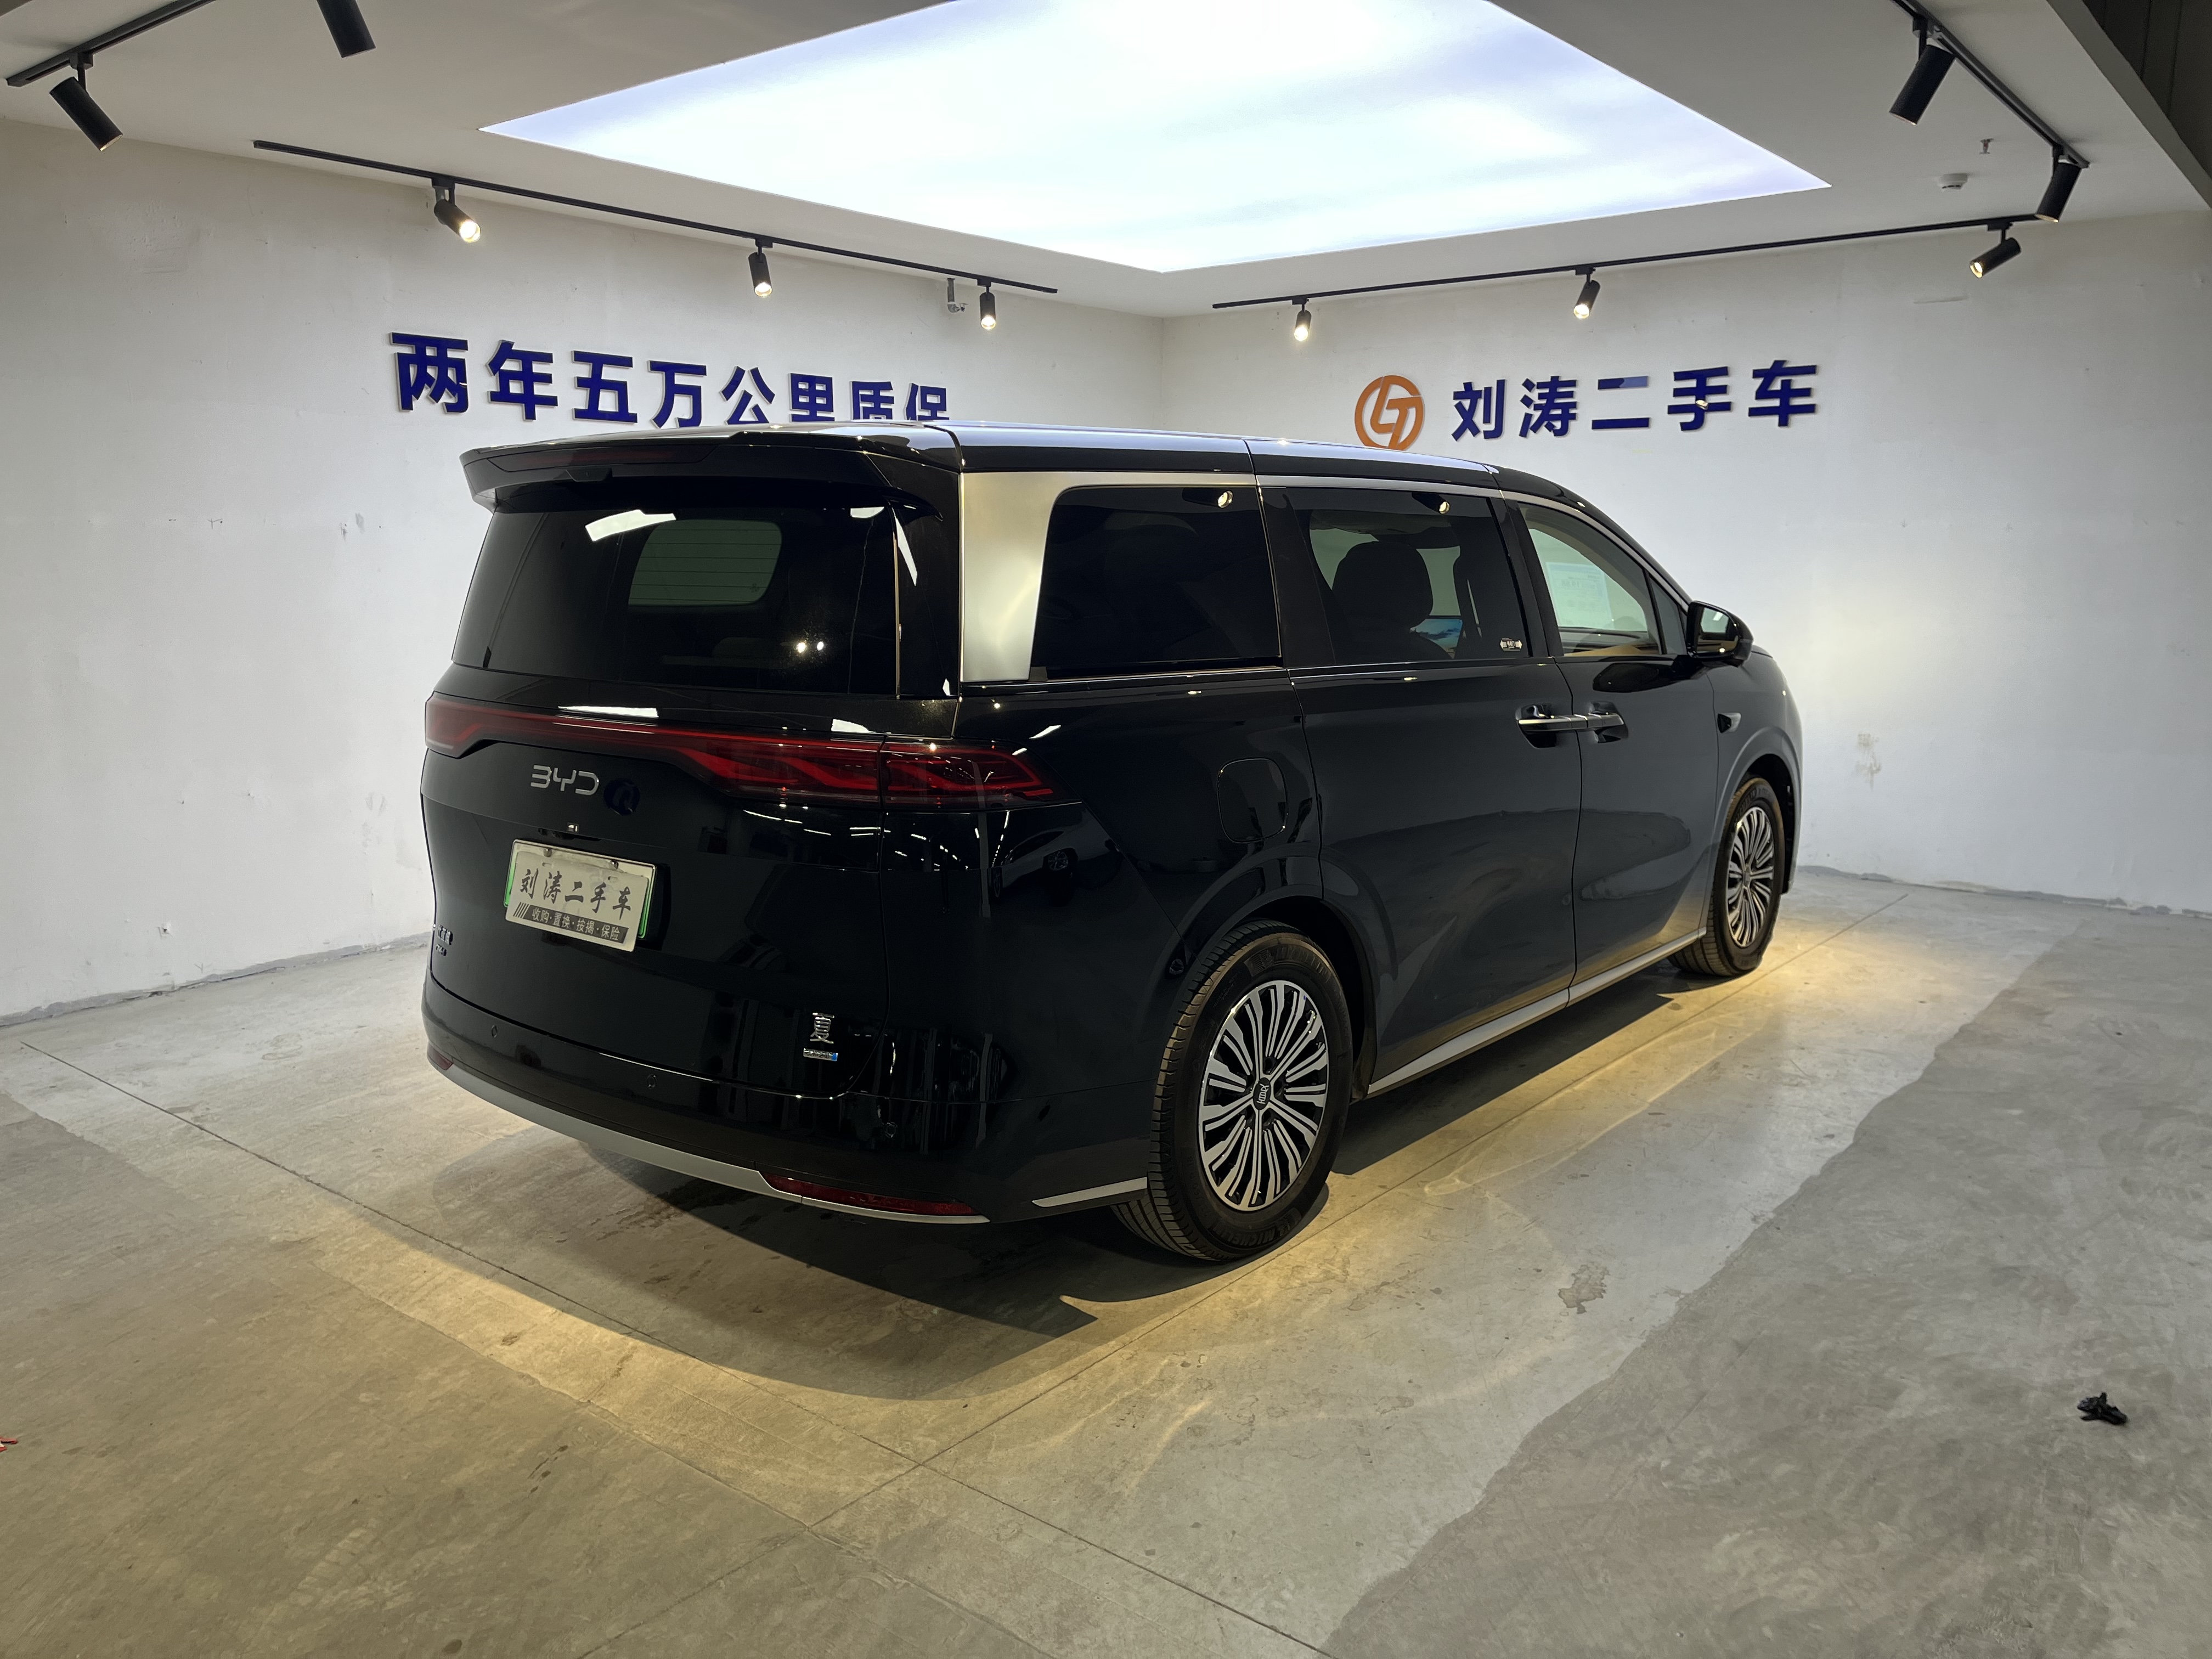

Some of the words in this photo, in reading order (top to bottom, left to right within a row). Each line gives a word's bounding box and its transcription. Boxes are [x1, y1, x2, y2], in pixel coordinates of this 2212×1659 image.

[389, 331, 950, 428] 两年五万公里质保
[1451, 359, 1818, 442] 刘涛二手车
[531, 764, 599, 795] BYD
[520, 868, 631, 921] 刘涛二手车
[810, 1012, 835, 1044] 夏
